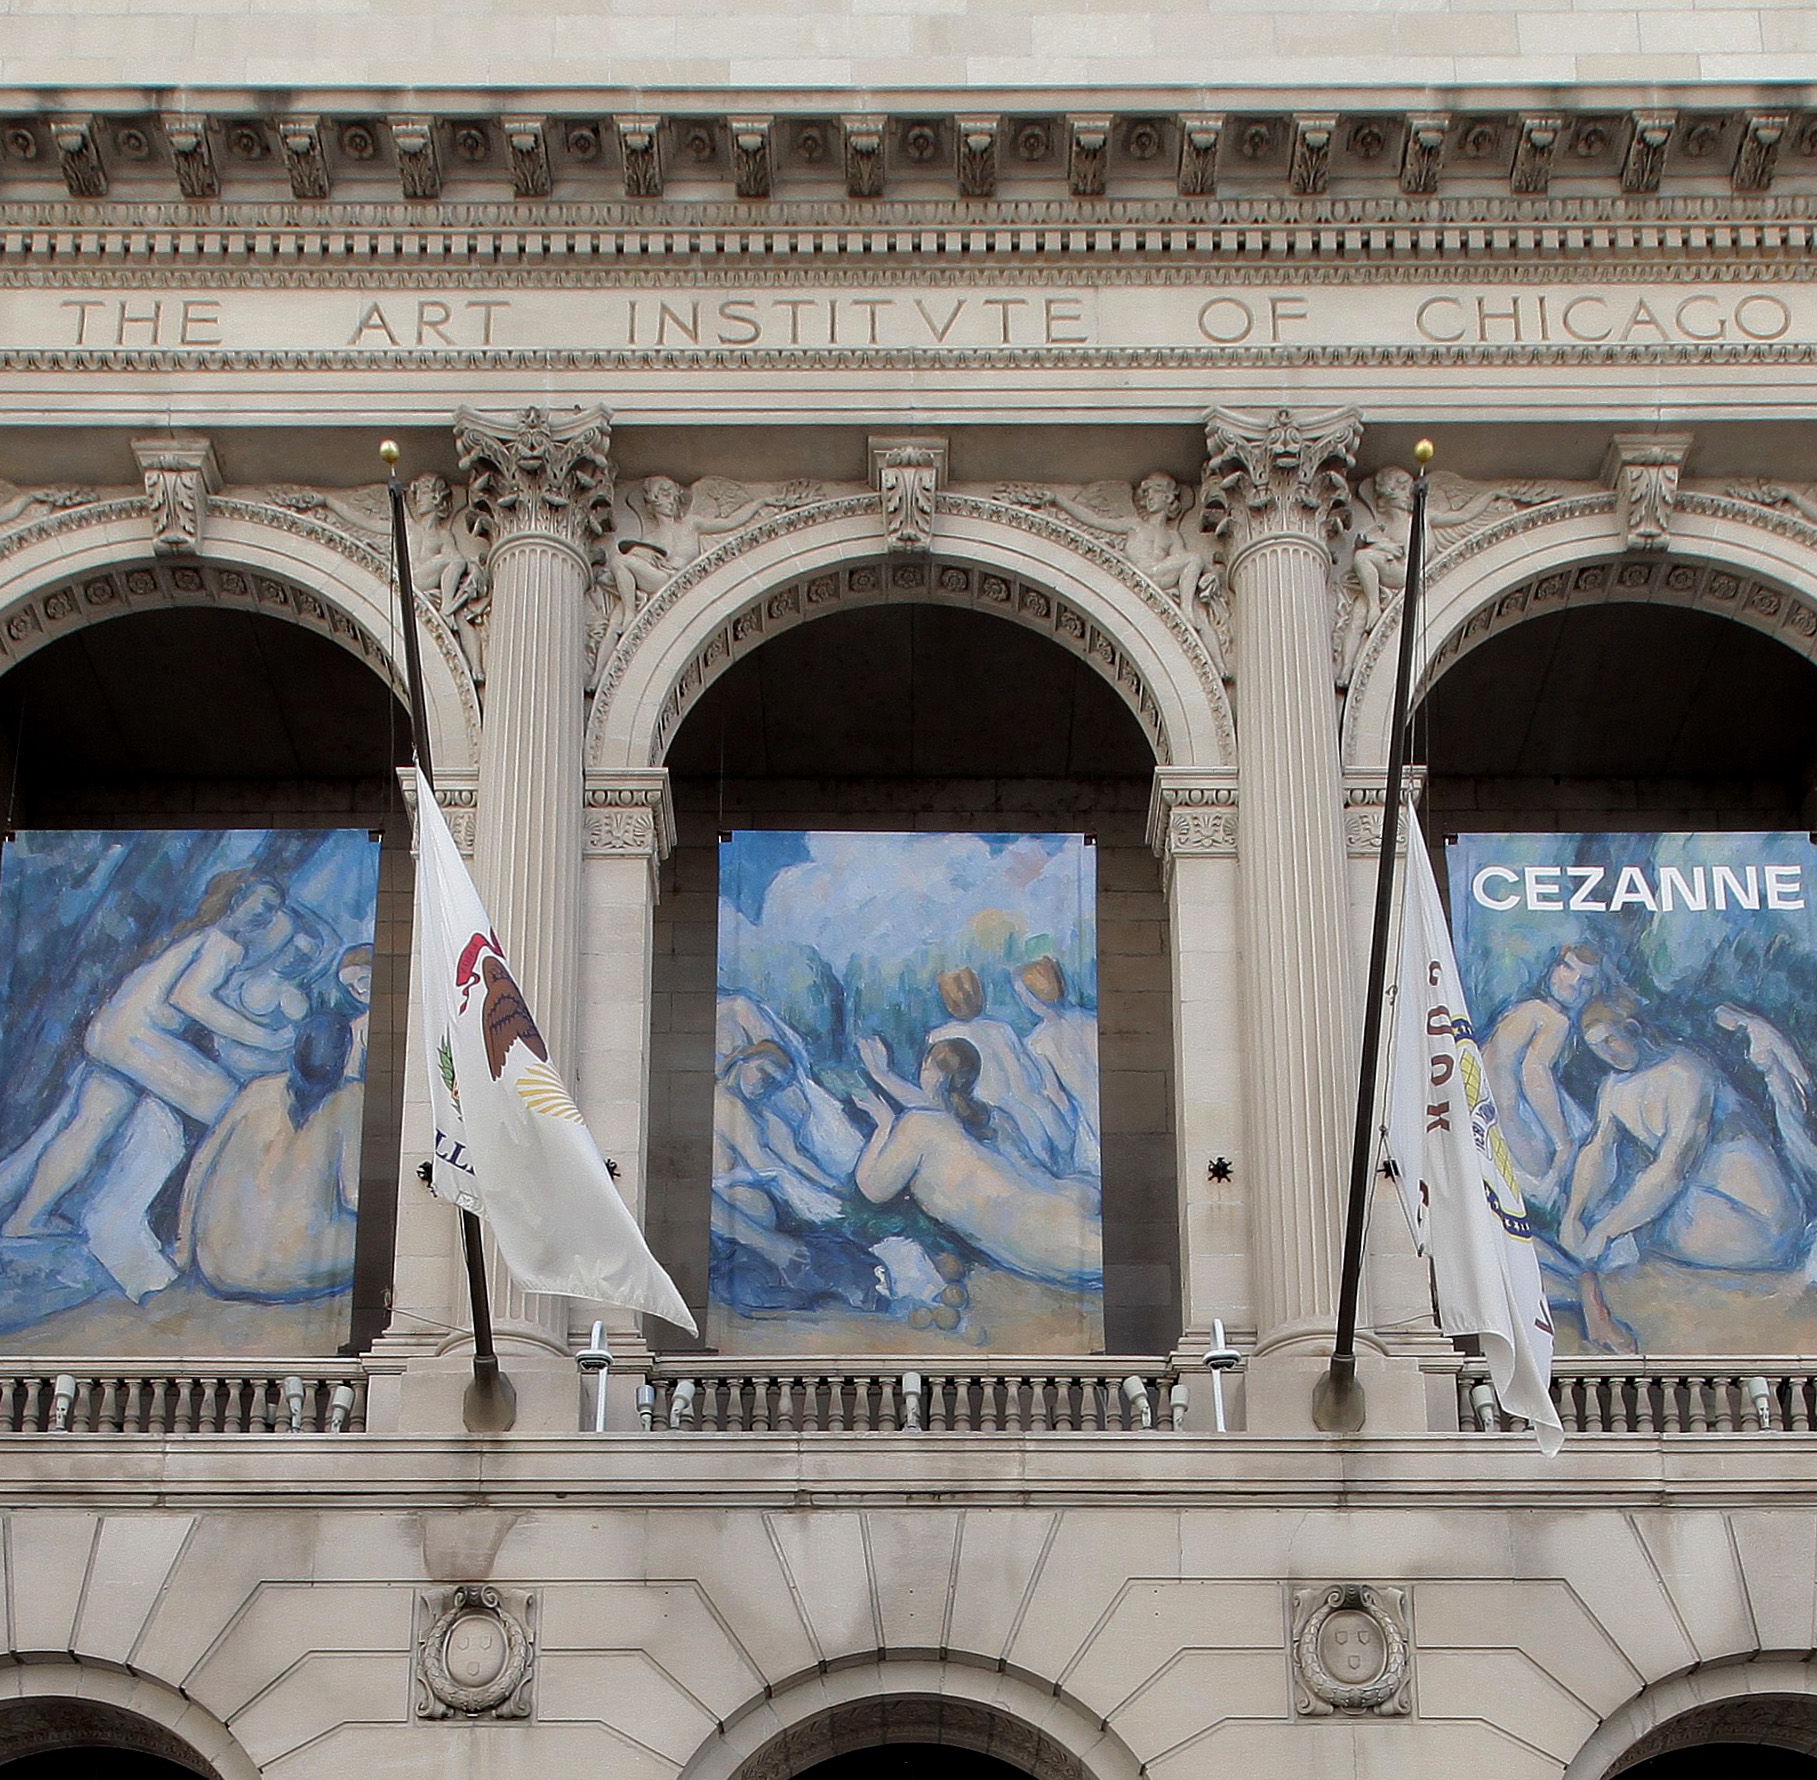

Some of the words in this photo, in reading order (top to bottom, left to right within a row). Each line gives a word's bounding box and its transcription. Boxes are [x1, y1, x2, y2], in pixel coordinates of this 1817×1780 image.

[59, 300, 224, 346] THE
[346, 300, 513, 346] ART
[623, 298, 1090, 346] INSTITVTE
[1196, 296, 1309, 344] OF
[1415, 294, 1793, 342] CHICAGO
[1471, 864, 1806, 912] CEZANNE
